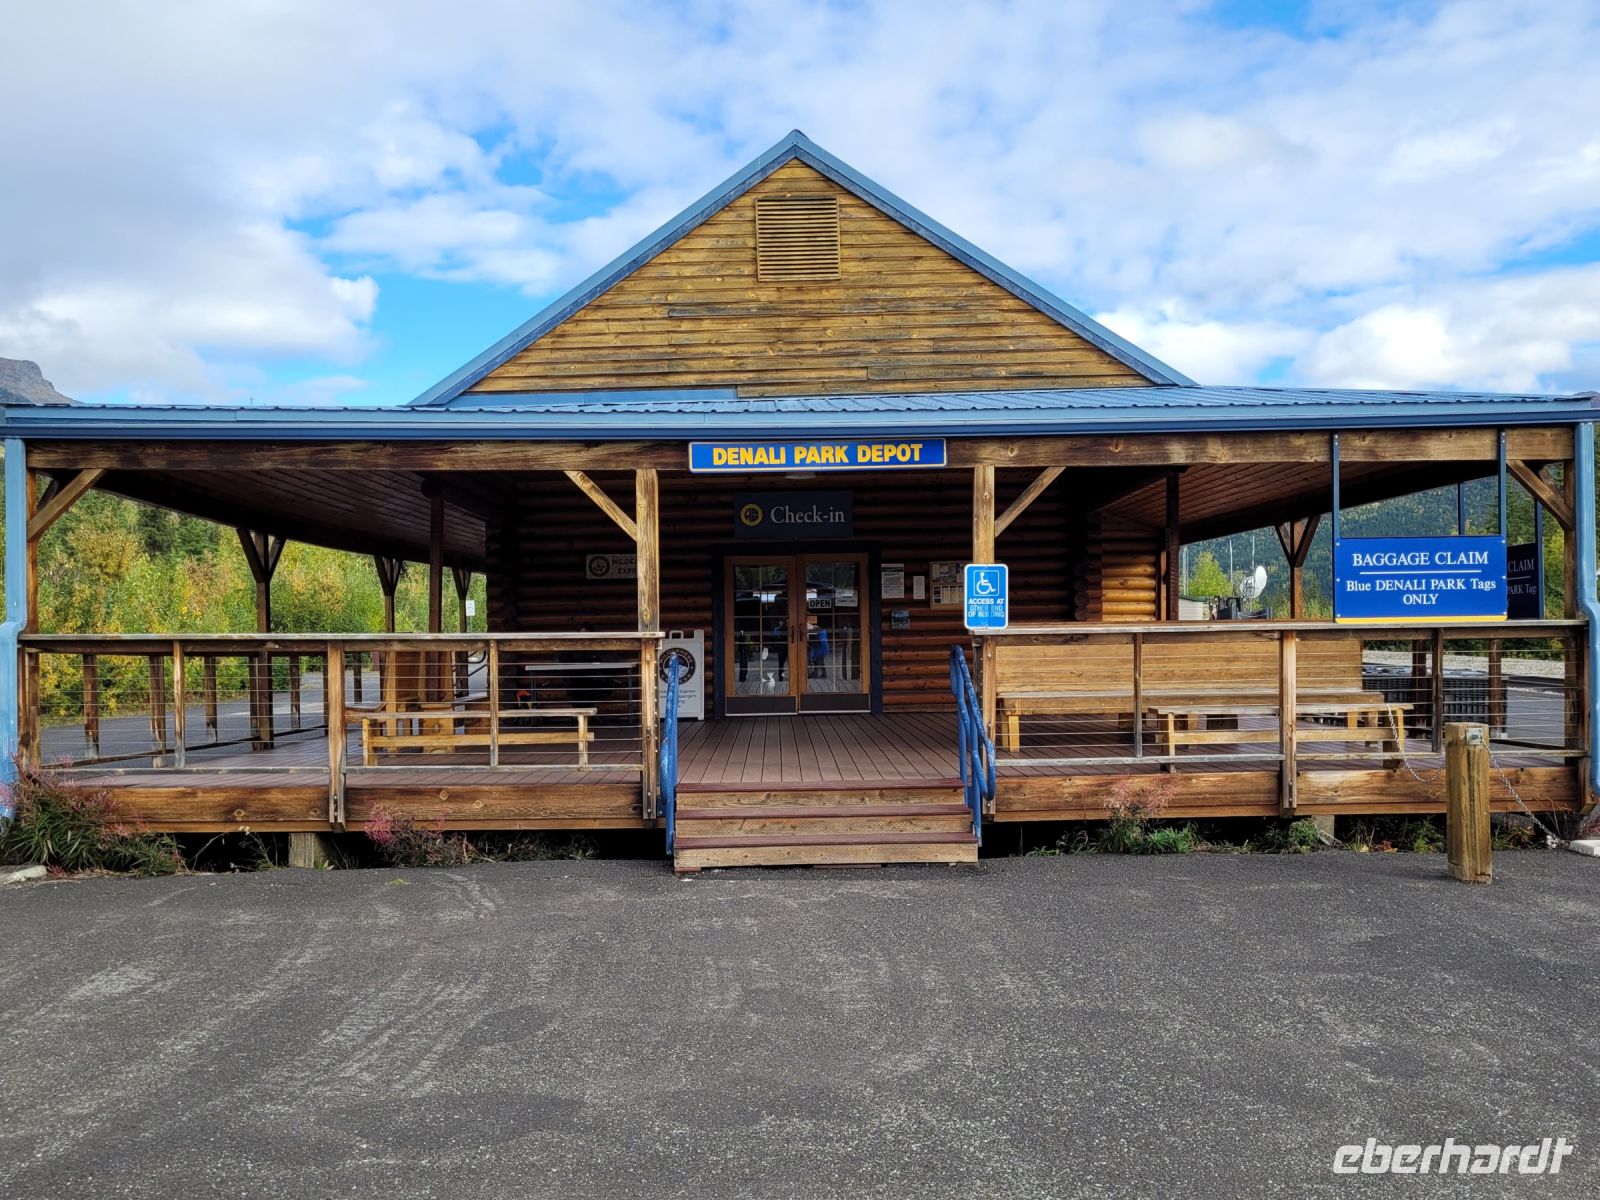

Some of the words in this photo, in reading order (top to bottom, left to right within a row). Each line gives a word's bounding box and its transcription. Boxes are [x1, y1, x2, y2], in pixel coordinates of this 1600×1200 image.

[713, 447, 786, 465] DENALI
[794, 446, 849, 464] PARK
[857, 444, 923, 463] DEPOT
[770, 505, 845, 524] Check-in
[1352, 553, 1430, 566] BAGGAGE
[1435, 552, 1489, 565] CLAIM
[1507, 559, 1535, 573] CLAIM
[1346, 580, 1372, 591] Blue
[1376, 580, 1426, 591] DENALI
[1431, 579, 1466, 590] PARK
[1470, 579, 1496, 591] Tags
[810, 599, 831, 608] OPEN
[1403, 594, 1439, 605] ONLY
